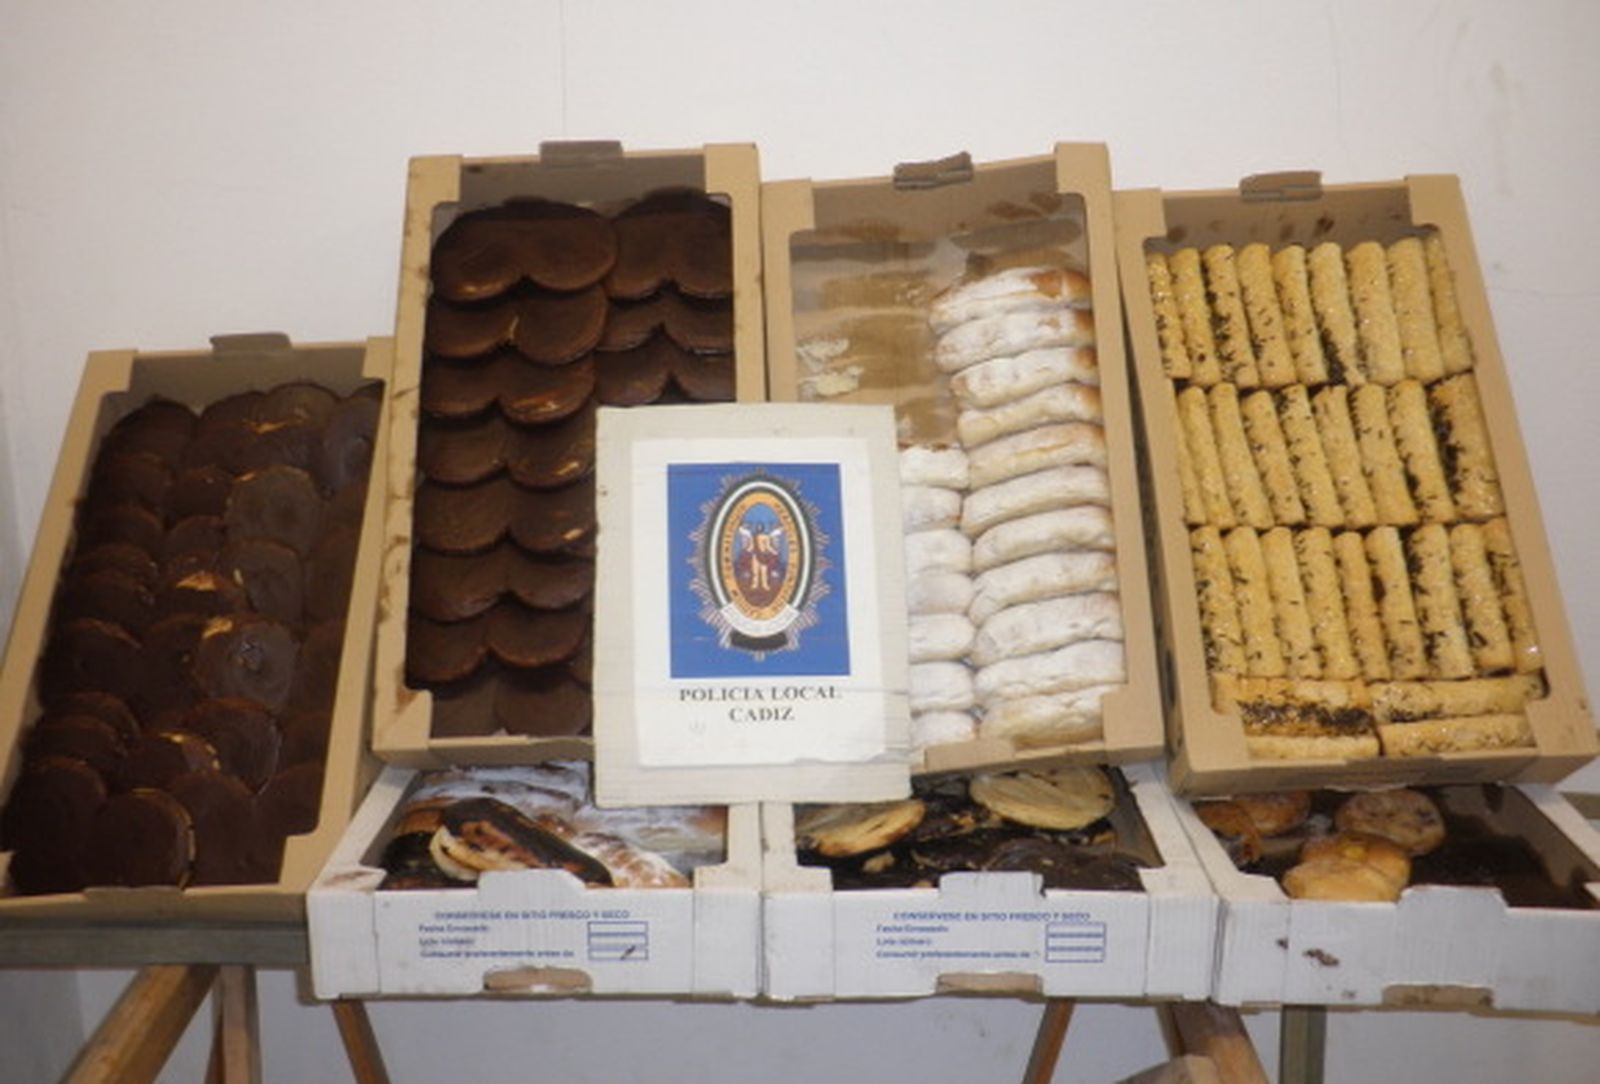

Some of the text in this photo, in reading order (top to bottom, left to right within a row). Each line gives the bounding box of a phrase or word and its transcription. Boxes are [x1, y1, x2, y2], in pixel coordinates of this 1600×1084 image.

[679, 685, 843, 701] POLICIA LOCAL
[728, 707, 795, 722] CADIZ
